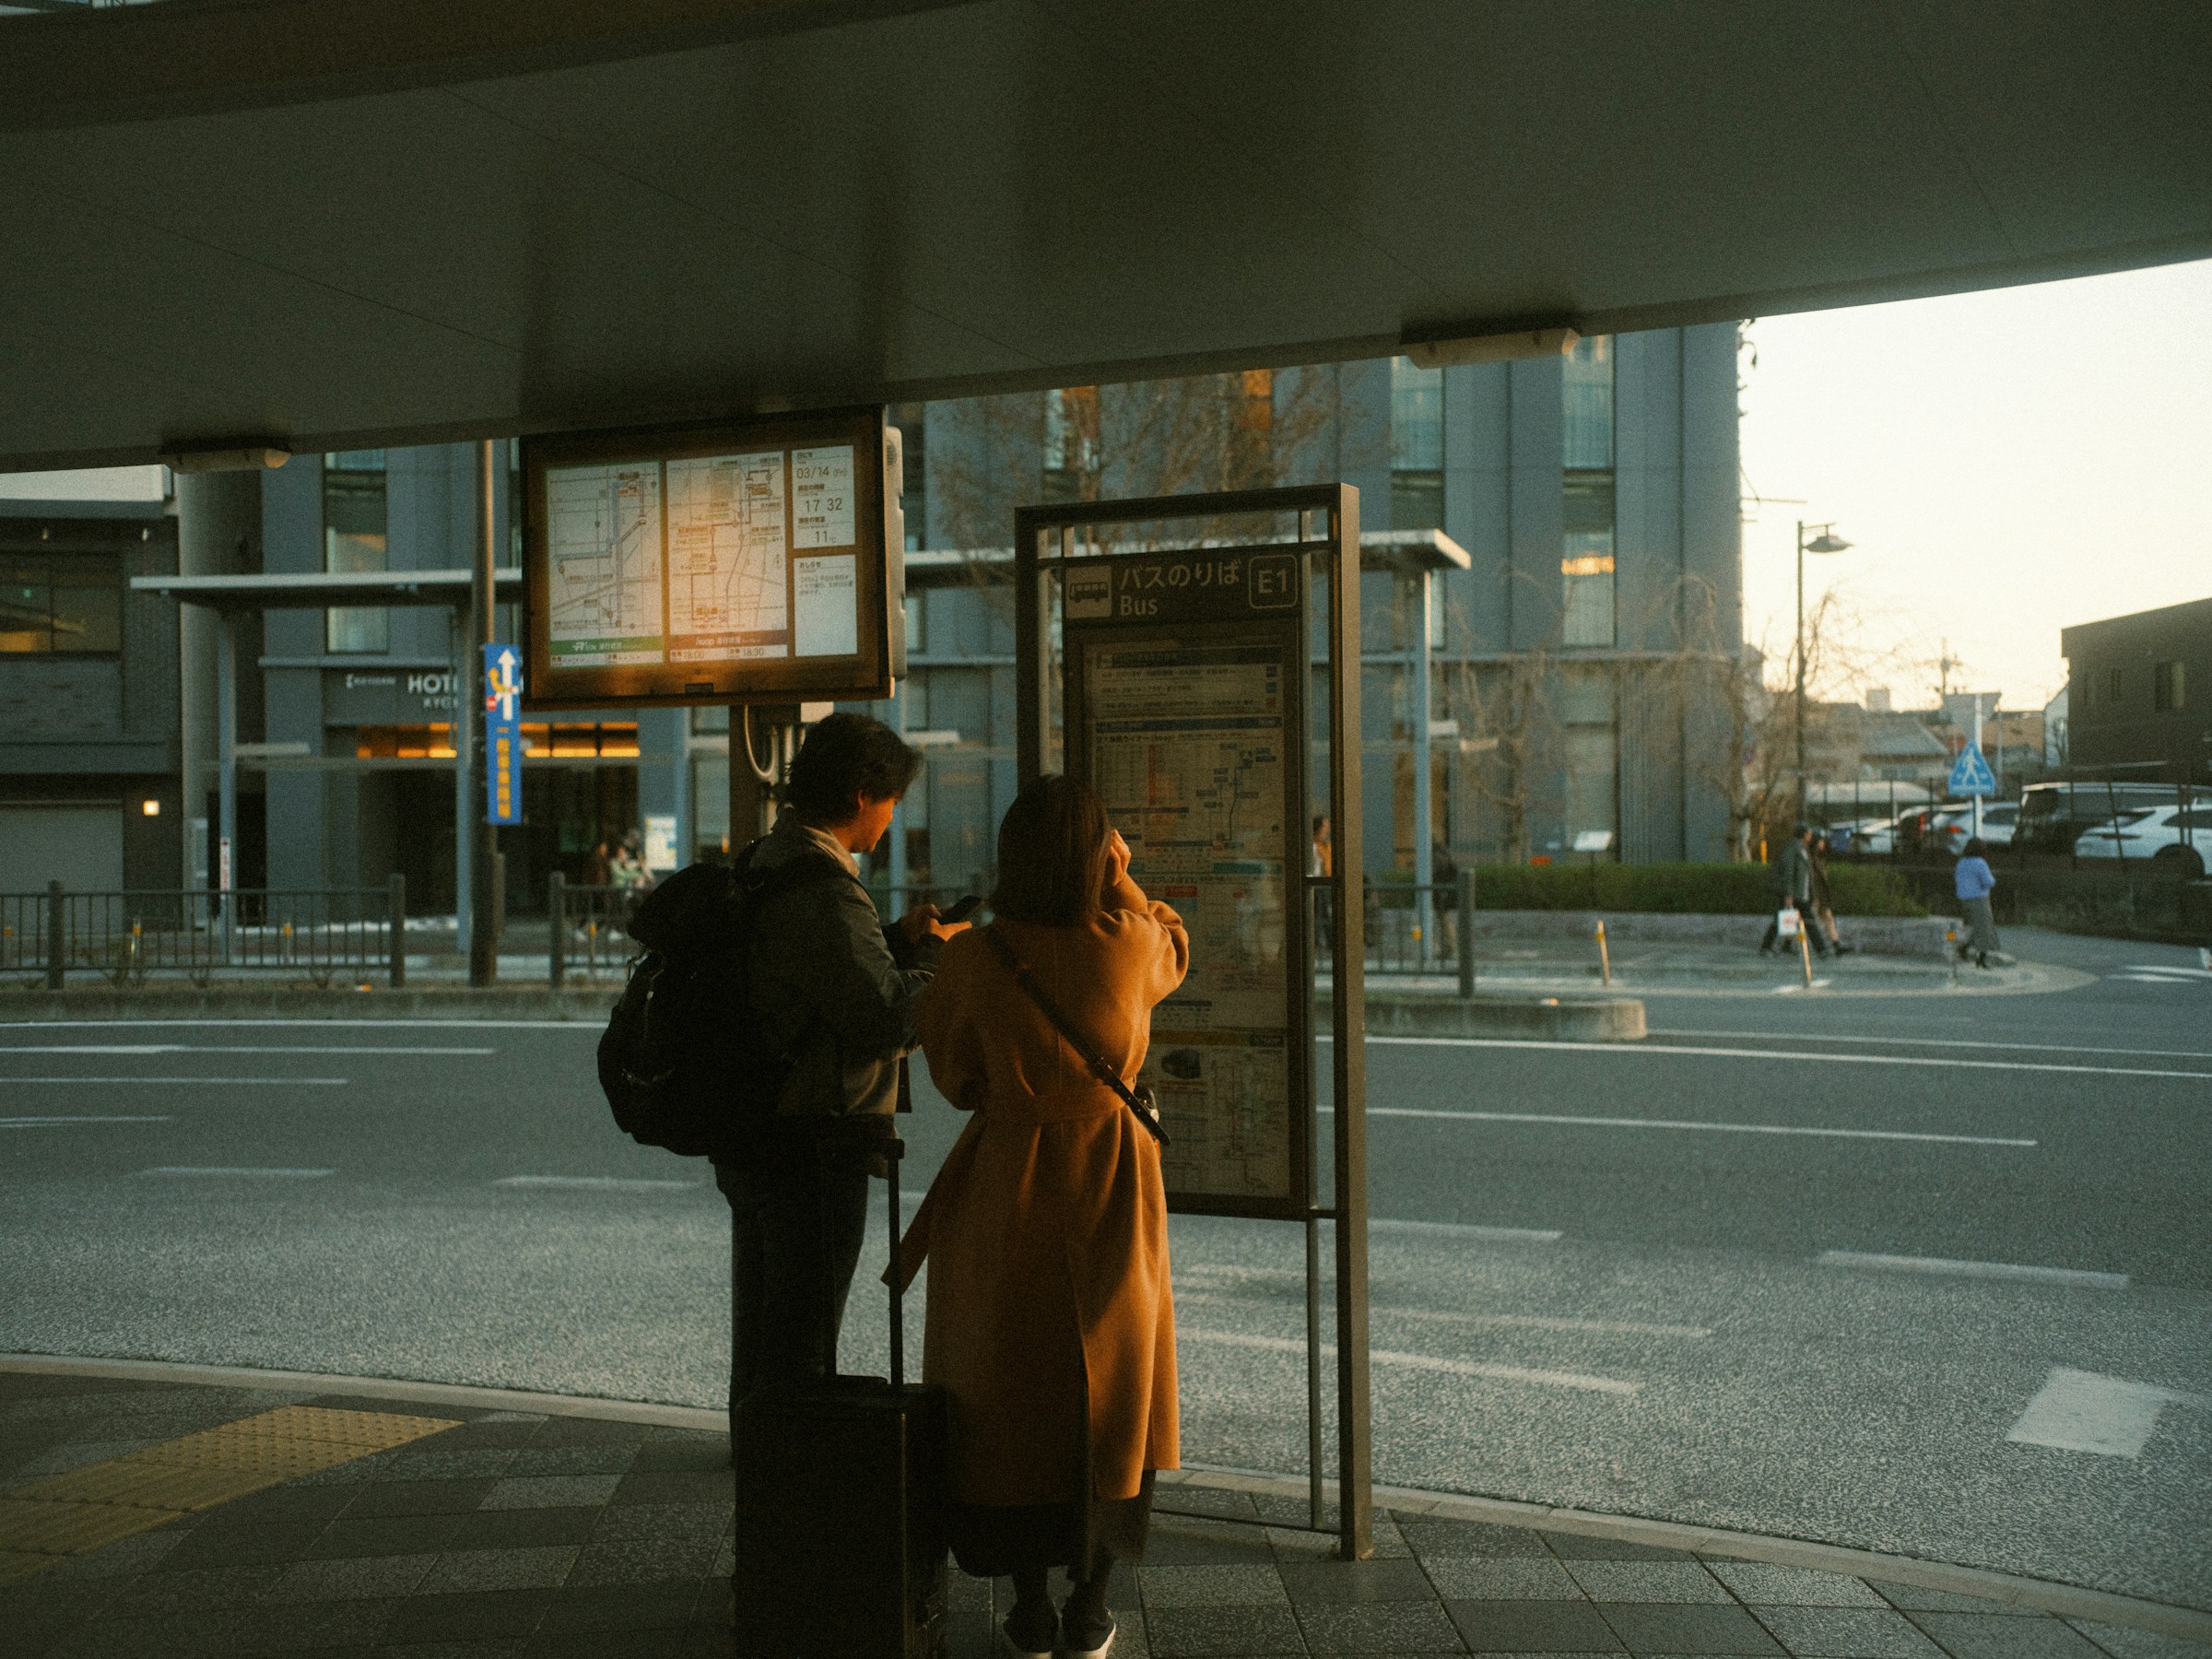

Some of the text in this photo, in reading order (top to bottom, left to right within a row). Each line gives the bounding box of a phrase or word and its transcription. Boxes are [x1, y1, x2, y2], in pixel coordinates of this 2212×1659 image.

[796, 465, 830, 479] 03/14
[806, 498, 842, 512] 17 32
[816, 530, 828, 544] 11
[1120, 559, 1241, 591] バスのりば
[1258, 569, 1288, 594] E1
[1120, 594, 1159, 616] Bus
[742, 647, 765, 657] 18:30
